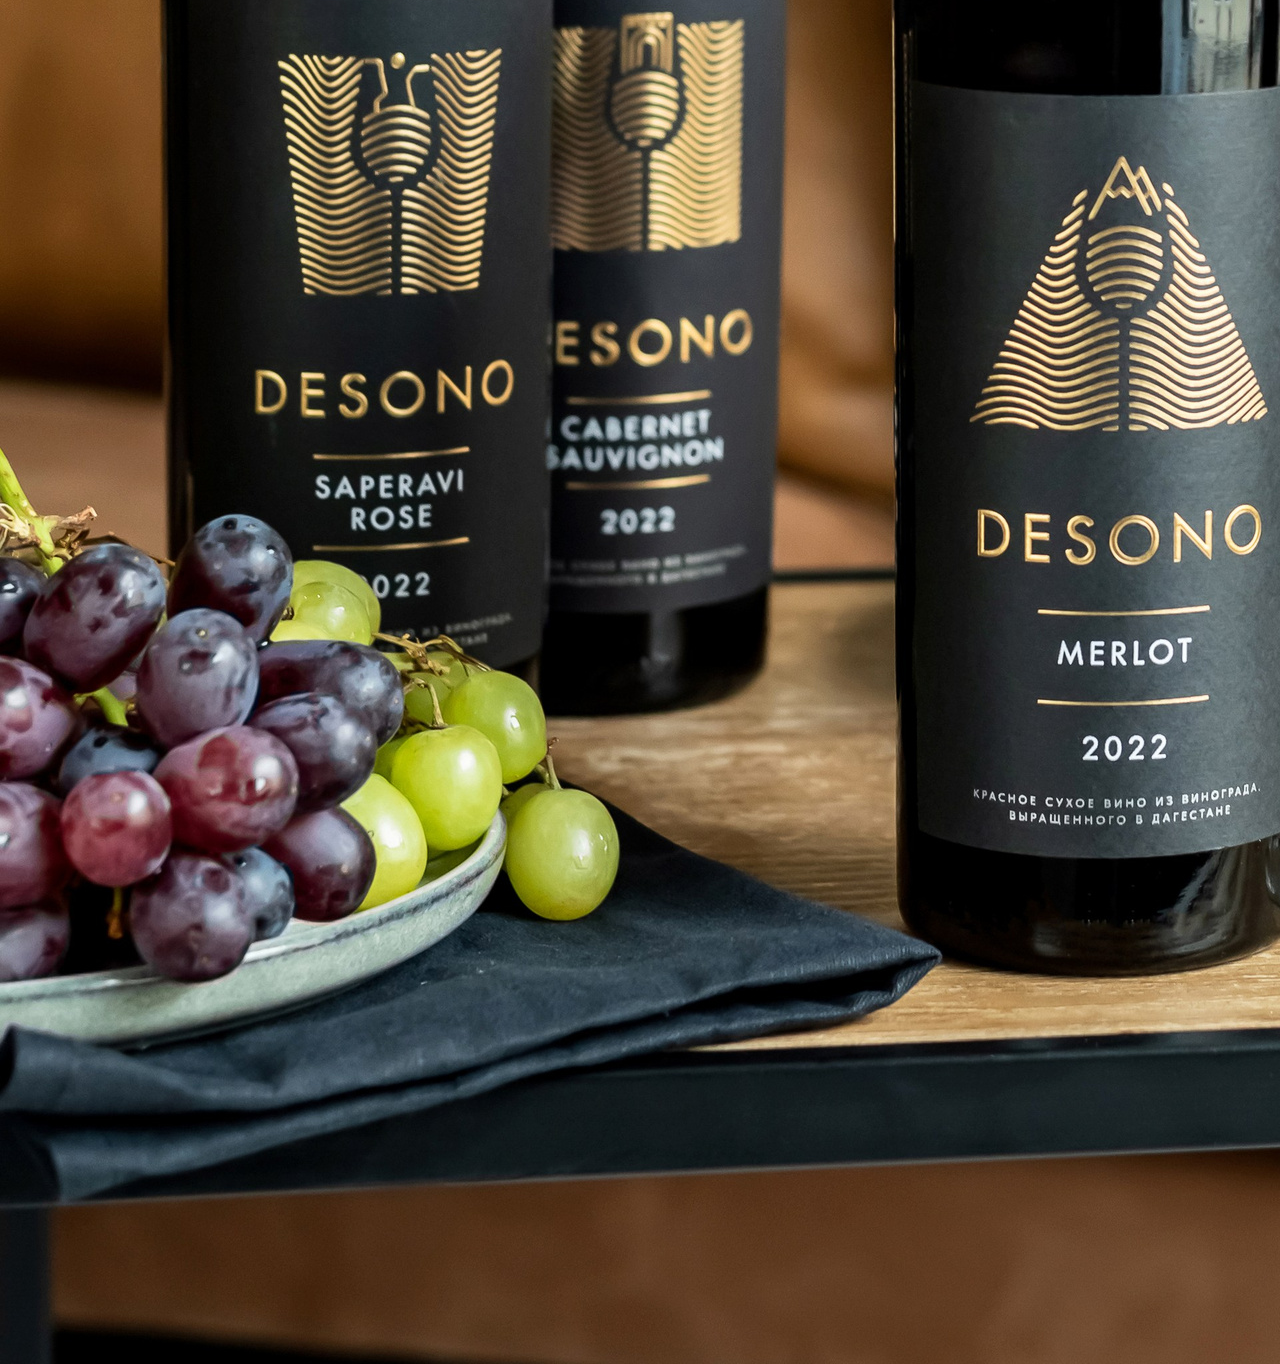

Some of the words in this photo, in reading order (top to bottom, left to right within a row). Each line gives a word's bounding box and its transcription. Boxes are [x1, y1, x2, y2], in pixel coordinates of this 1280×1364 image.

[555, 308, 753, 367] ESONO
[255, 359, 514, 419] DESONO
[560, 409, 711, 442] CABERNET
[314, 468, 465, 499] SAPERAVI
[350, 504, 433, 531] ROSE
[601, 506, 676, 535] 2022
[977, 504, 1262, 566] DESONO
[361, 571, 432, 599] 022
[1057, 637, 1193, 666] MERLOT
[1082, 734, 1167, 761] 2022
[973, 788, 1037, 807] КРАСНОЕ
[1045, 797, 1095, 809] СУХОЕ
[1103, 797, 1147, 809] ВИНО
[1155, 795, 1174, 807] ИЗ
[1008, 810, 1127, 826] ВЫРАЩЕННОГО
[1135, 814, 1143, 825] В
[1151, 804, 1232, 825] ДАГЕСТАНЕ
